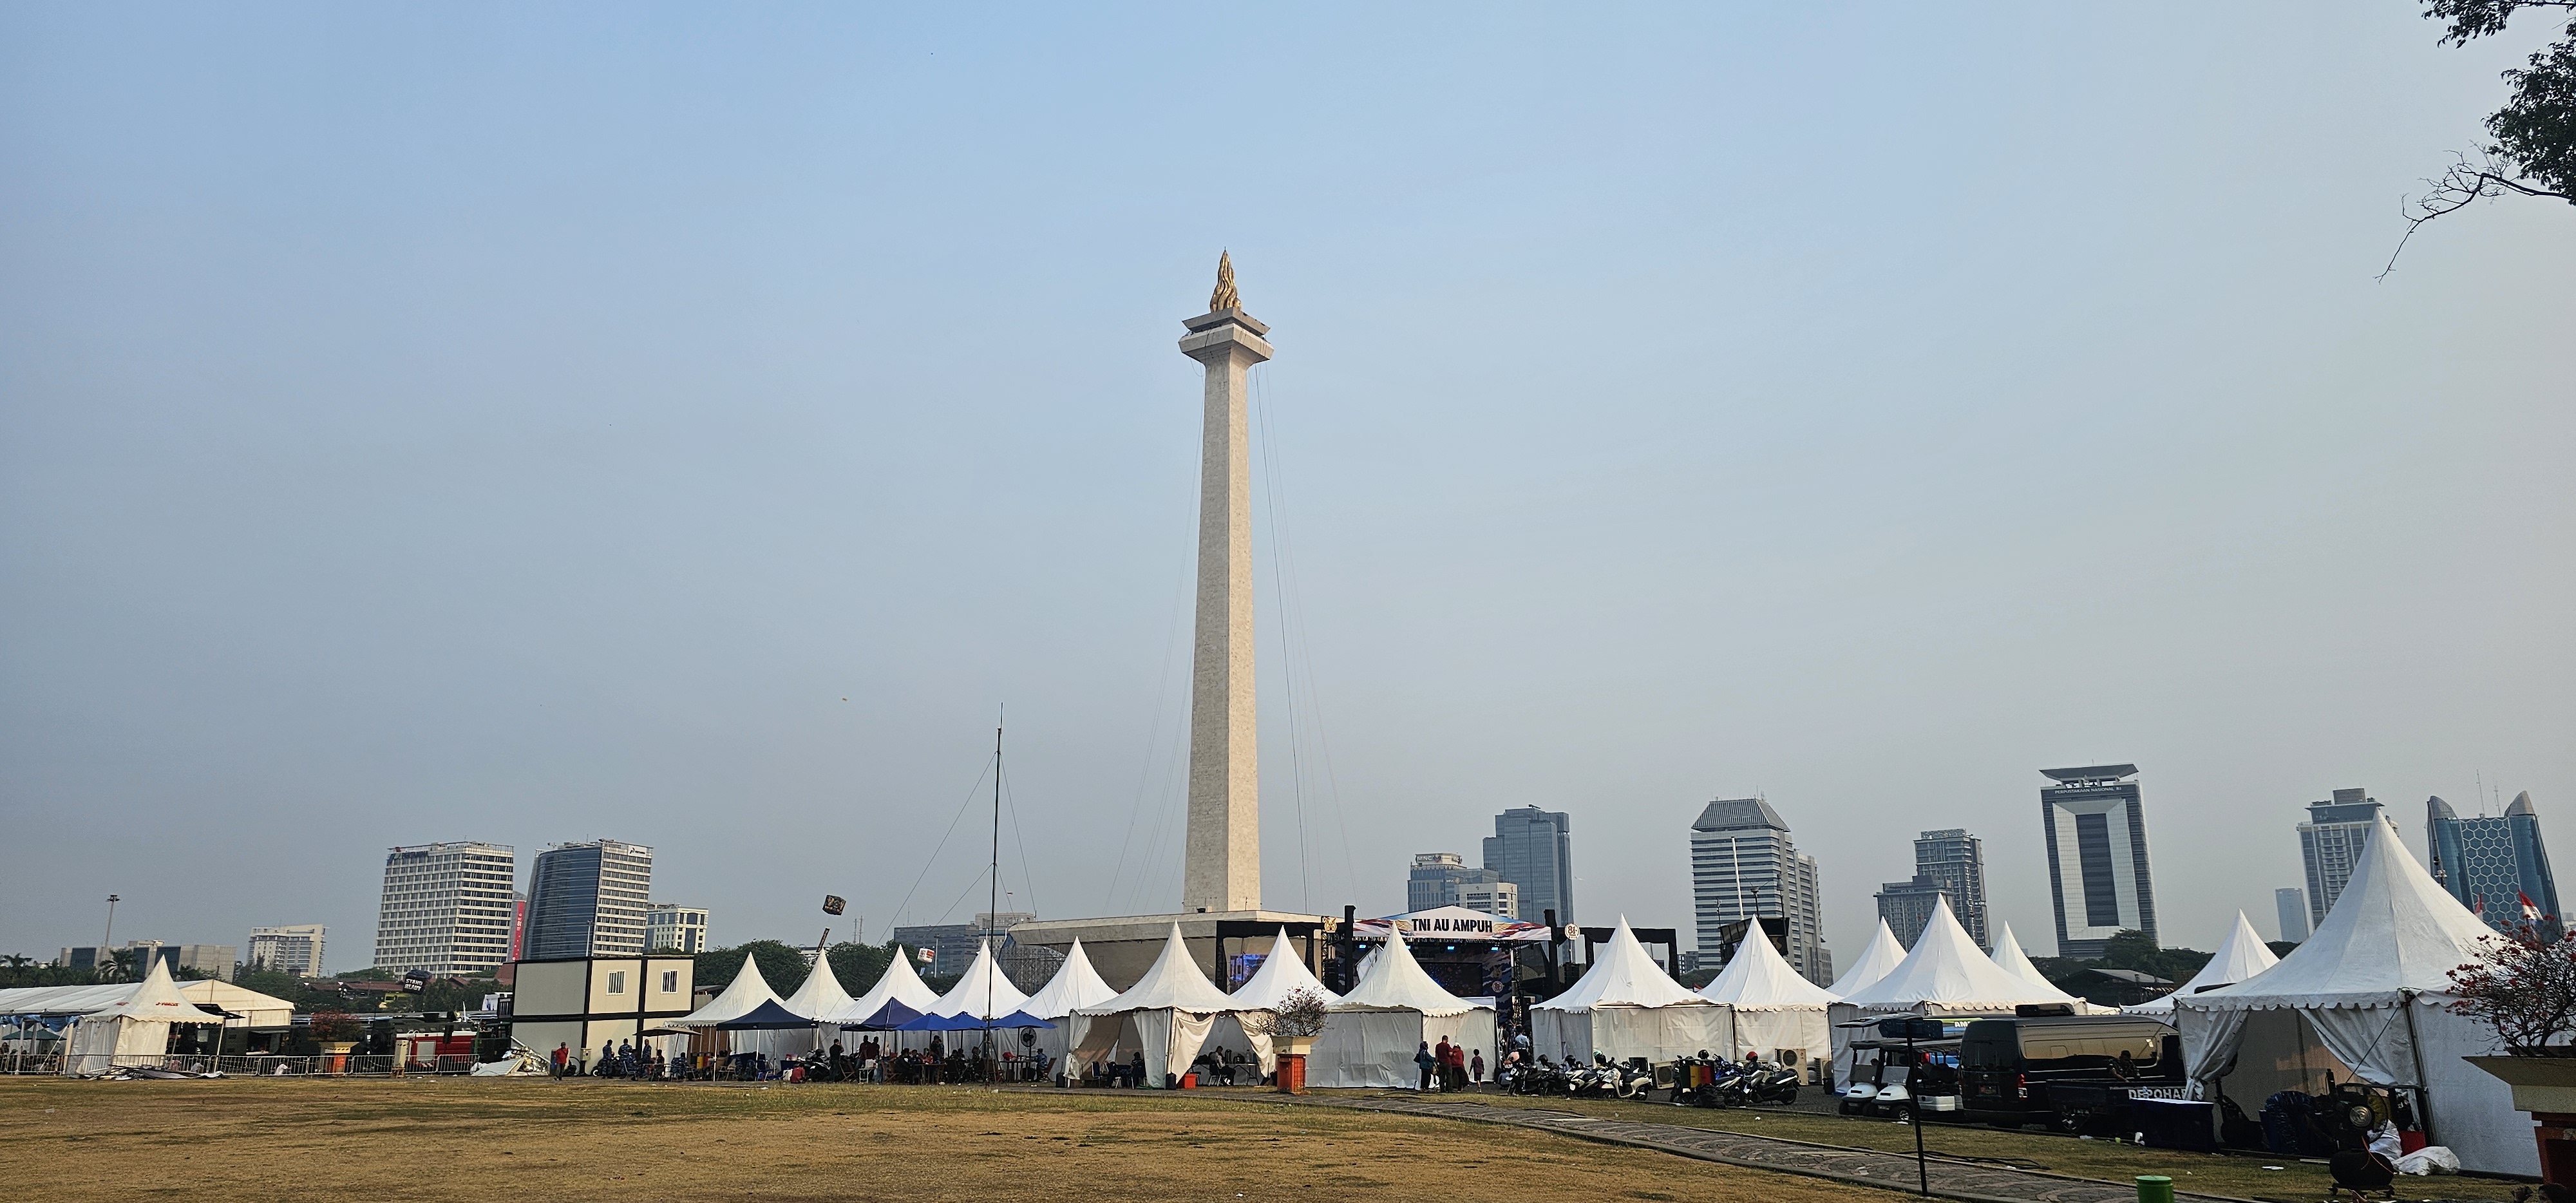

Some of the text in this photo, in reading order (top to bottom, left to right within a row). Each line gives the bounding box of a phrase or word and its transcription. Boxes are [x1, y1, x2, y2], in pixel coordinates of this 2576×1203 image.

[1411, 918, 1493, 933] TNI AU AMPUH
